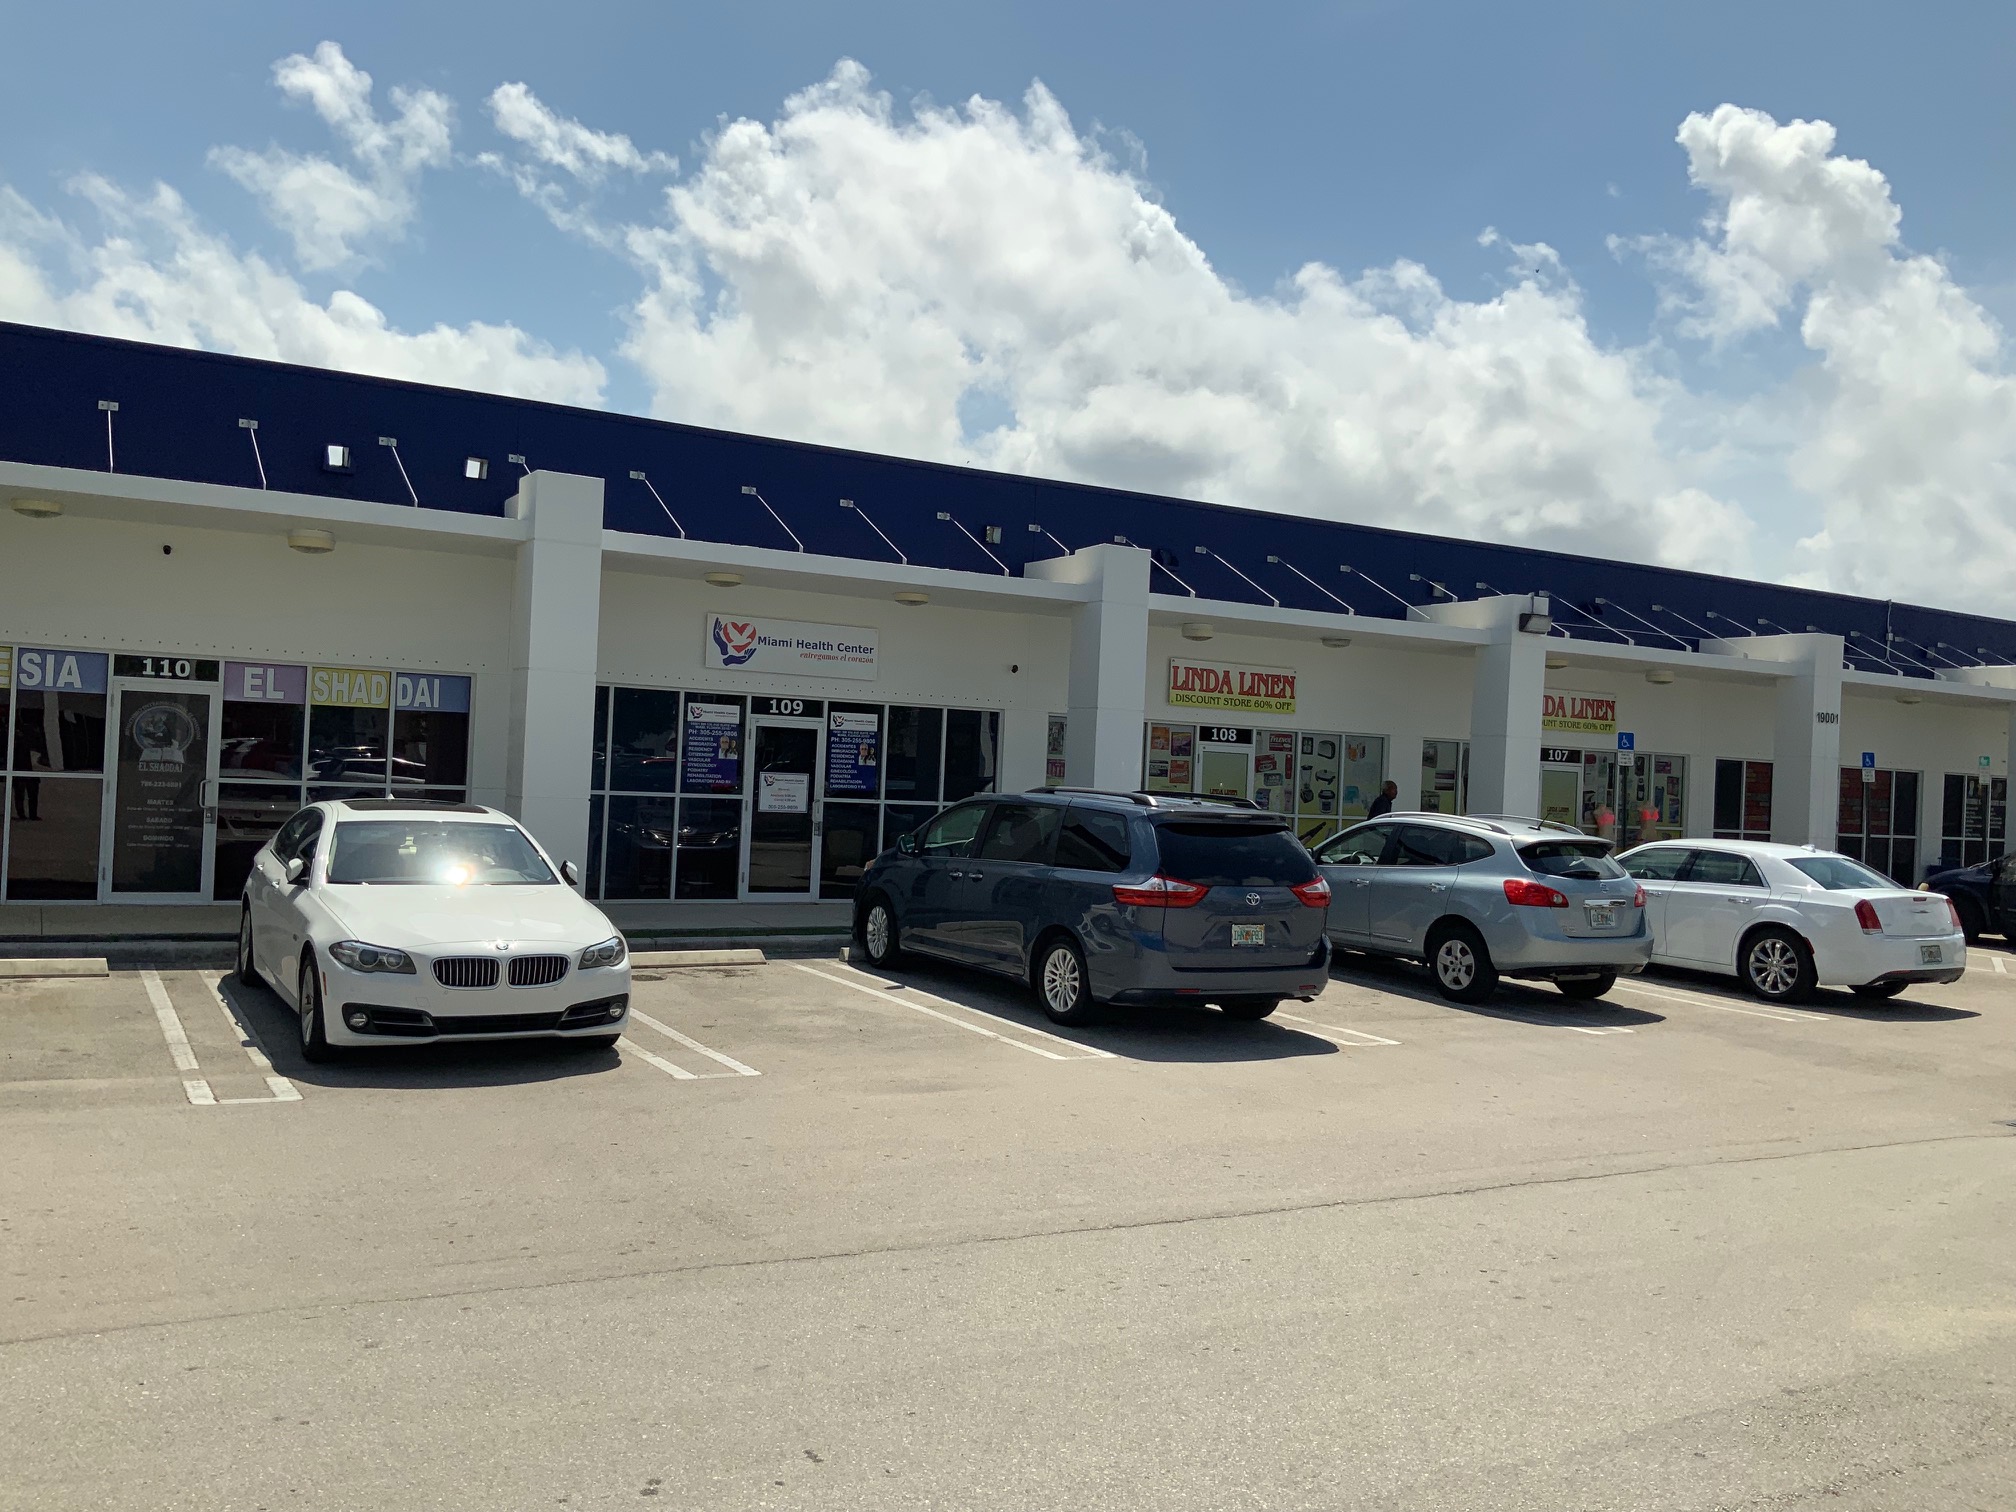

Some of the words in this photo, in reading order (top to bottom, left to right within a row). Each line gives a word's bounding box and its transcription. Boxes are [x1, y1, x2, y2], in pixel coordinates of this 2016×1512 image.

[757, 636, 792, 648] Miami
[796, 639, 833, 651] Health
[837, 643, 874, 654] Center
[800, 651, 839, 661] entregamos
[840, 654, 847, 662] el
[142, 658, 191, 678] 110
[243, 666, 285, 700] EL
[1171, 665, 1234, 695] LINDA
[1238, 671, 1296, 699] LINEN
[768, 698, 804, 715] 109
[1175, 693, 1222, 705] DISCOUNT
[1223, 697, 1252, 708] STORE
[1253, 700, 1273, 709] 60%
[1274, 701, 1292, 711] OFF
[1570, 697, 1616, 721] LINEN
[1558, 720, 1581, 729] STORE
[1582, 722, 1598, 730] 60%
[1599, 723, 1613, 731] OFF
[1816, 712, 1839, 724] 19001
[1211, 727, 1237, 742] 108
[1548, 749, 1569, 761] 107
